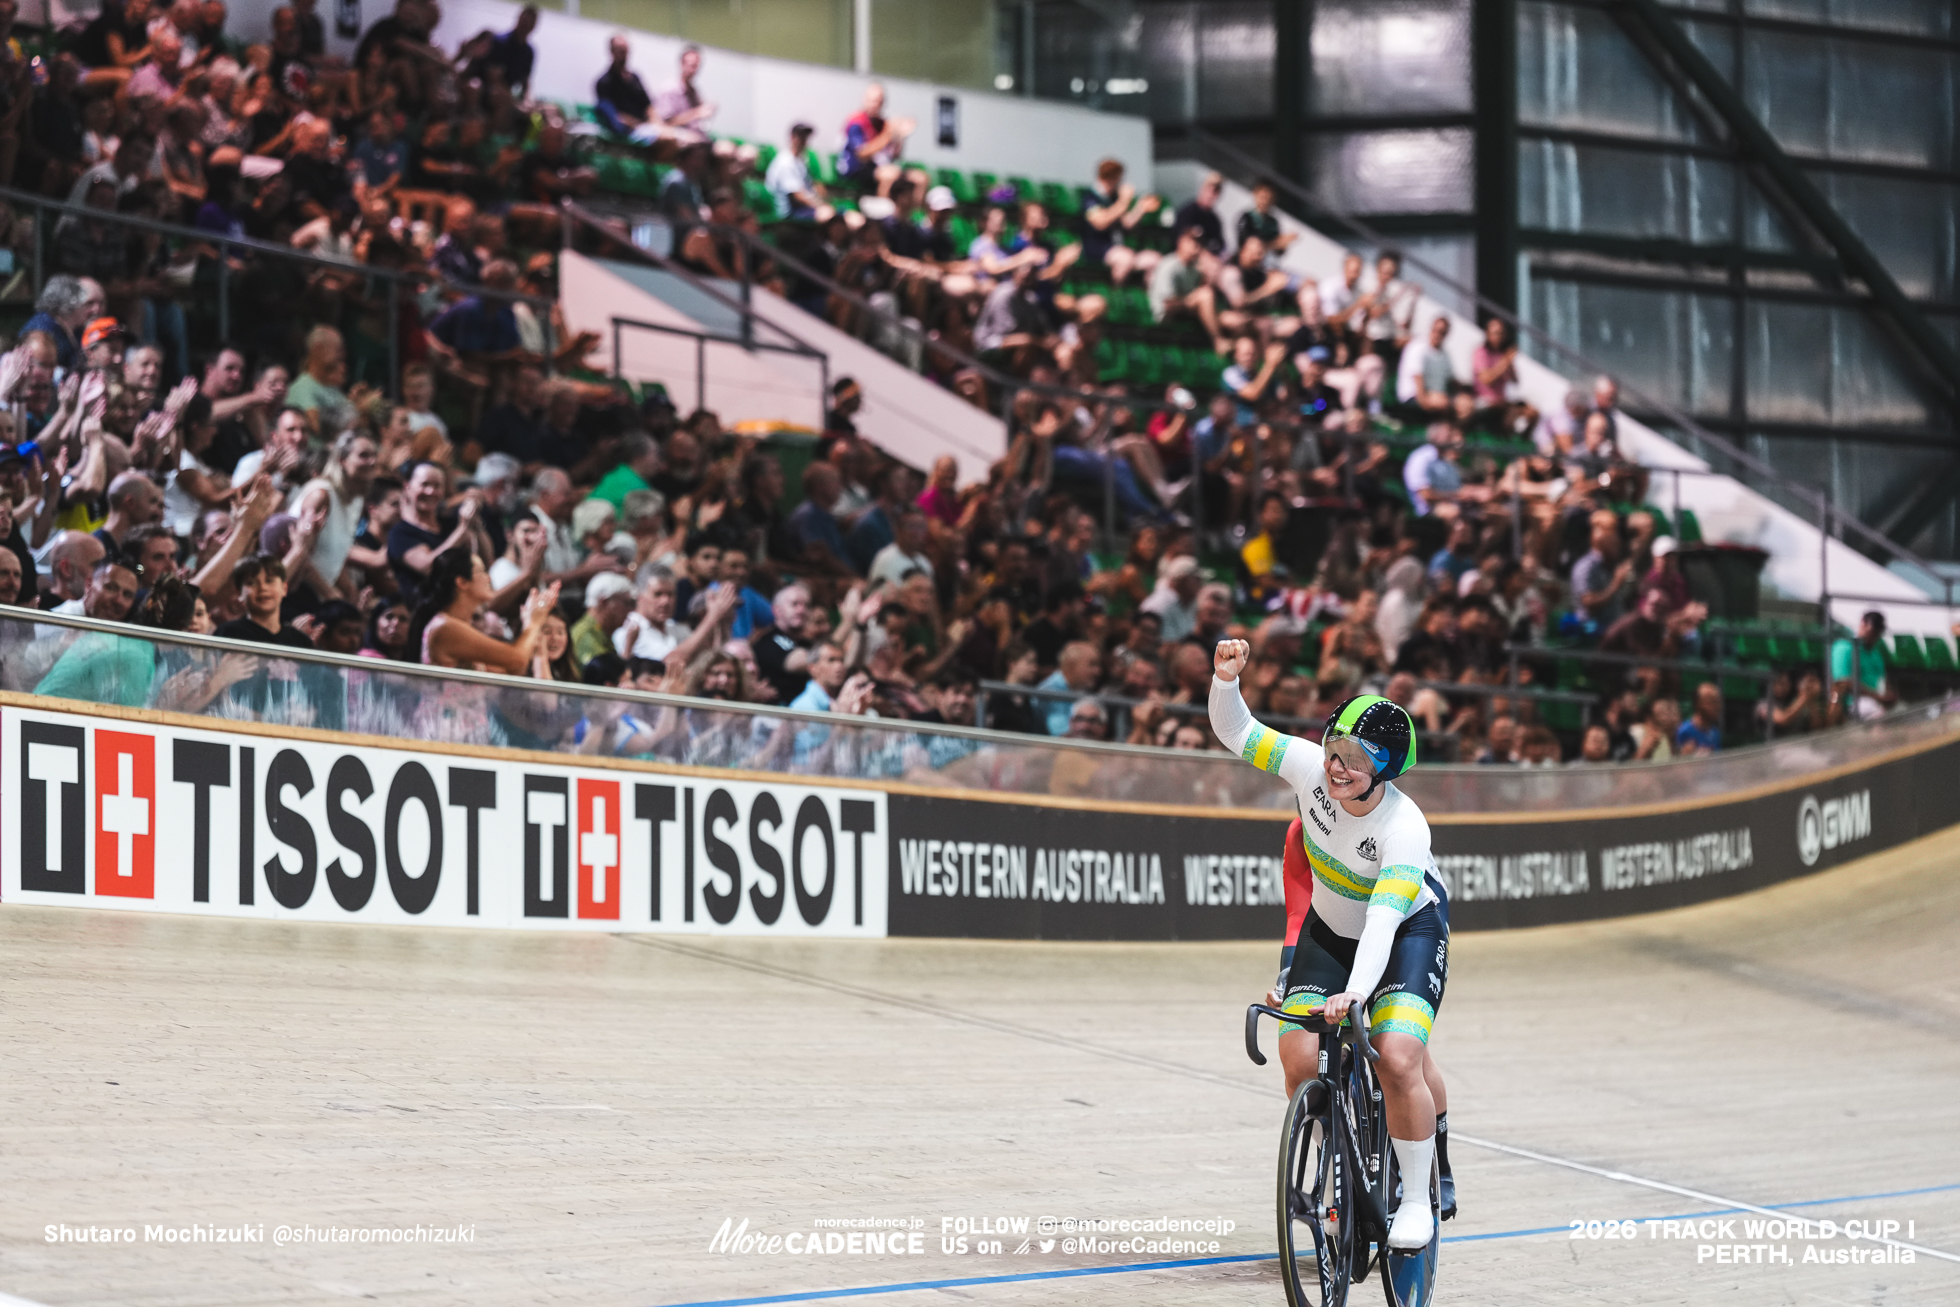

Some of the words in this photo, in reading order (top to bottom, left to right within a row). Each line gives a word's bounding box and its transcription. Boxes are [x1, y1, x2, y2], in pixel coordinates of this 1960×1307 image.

[172, 737, 497, 916] TISSOT
[1822, 789, 1872, 851] GWM
[634, 783, 876, 927] TISSOT
[899, 838, 1027, 899] WESTERN
[1031, 847, 1165, 905] AUSTRALIA
[1183, 853, 1286, 906] WESTERN
[1501, 850, 1591, 898] AUSTRALIA
[1602, 842, 1675, 891] WESTERN
[1675, 827, 1754, 879] AUSTRALIA
